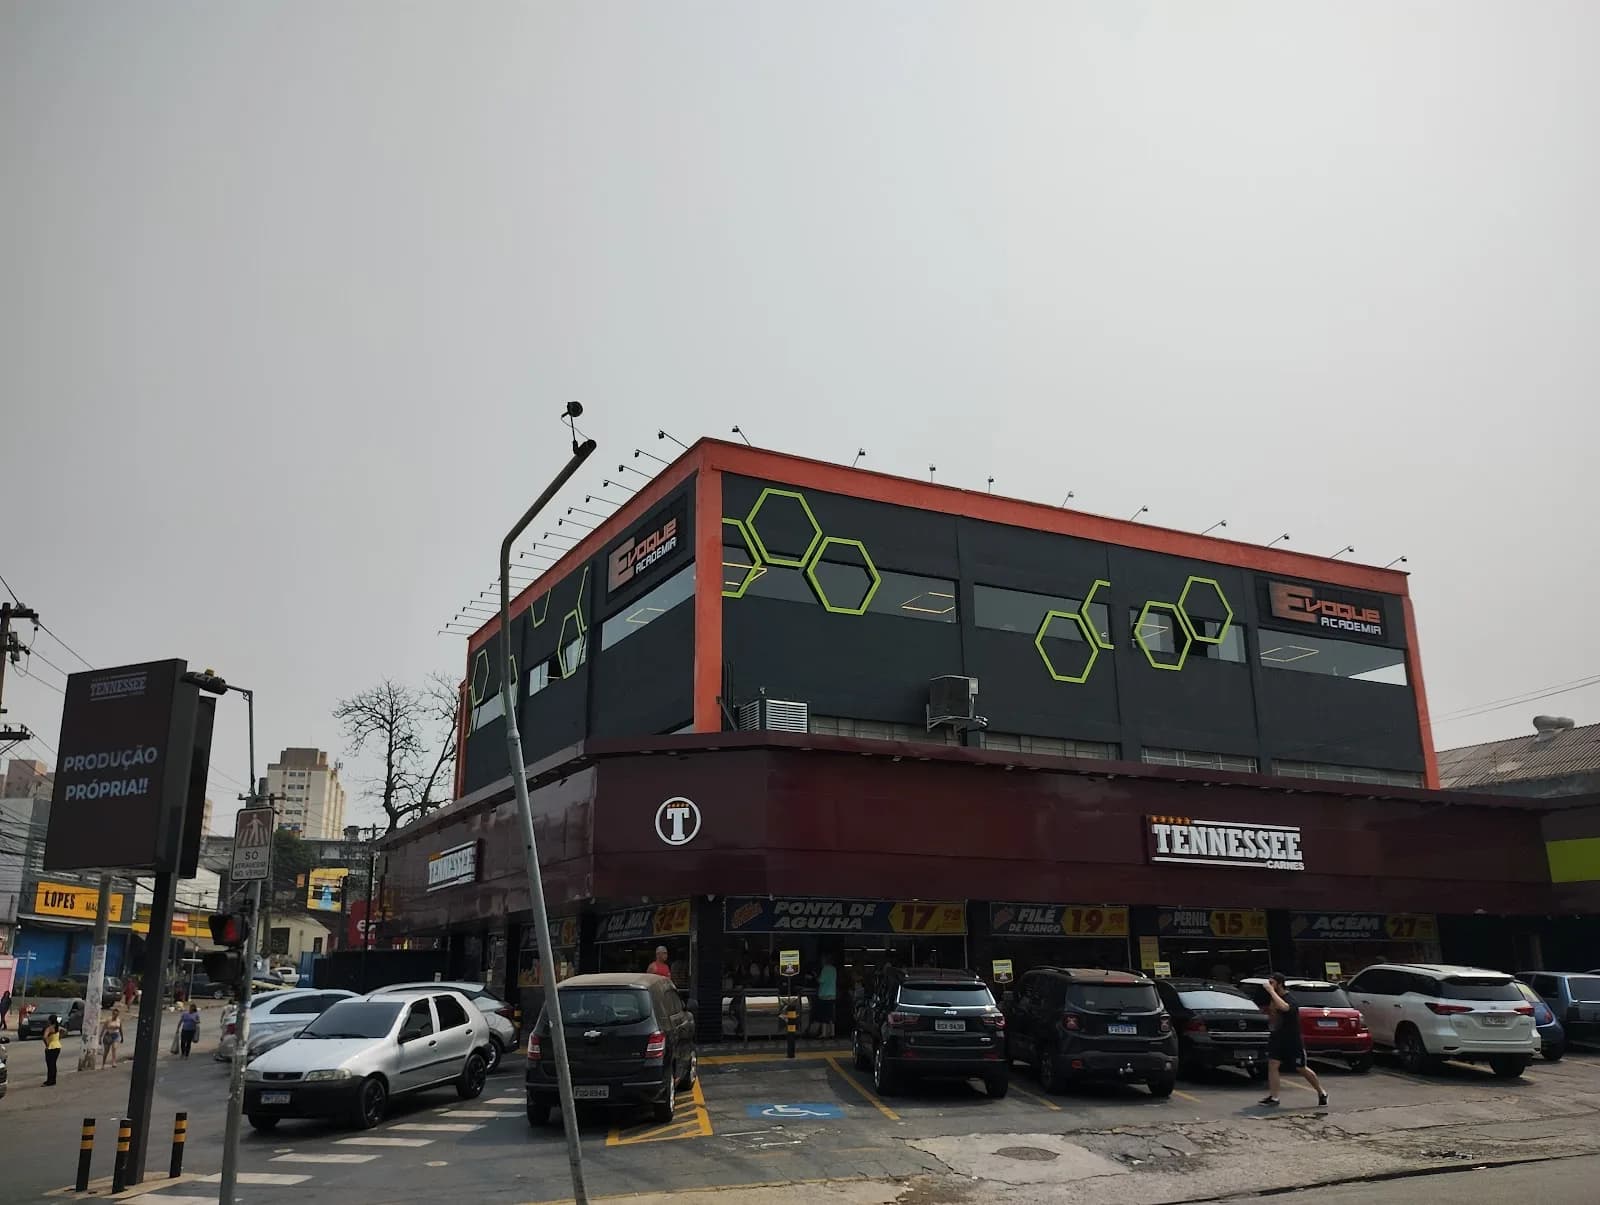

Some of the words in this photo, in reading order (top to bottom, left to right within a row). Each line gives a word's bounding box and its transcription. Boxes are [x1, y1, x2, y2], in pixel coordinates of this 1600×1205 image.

[635, 537, 677, 575] ACADEMIA
[1321, 616, 1382, 636] ACADEMIA
[90, 676, 147, 697] TENNESSEE
[63, 745, 157, 772] PRODUÇÃO
[65, 777, 149, 800] PRÓPRIA!!
[1152, 823, 1303, 861] TENNESSEE
[1266, 860, 1305, 871] CARNES
[44, 890, 76, 910] LOPES
[774, 902, 845, 916] PONTA
[848, 902, 877, 917] DE
[774, 915, 864, 930] AGULHA
[901, 904, 939, 930] 17
[1071, 909, 1103, 933] 19
[1173, 910, 1209, 927] PERNIL
[1214, 912, 1244, 934] 15
[1008, 922, 1022, 933] DE
[1023, 922, 1061, 934] FRANGO
